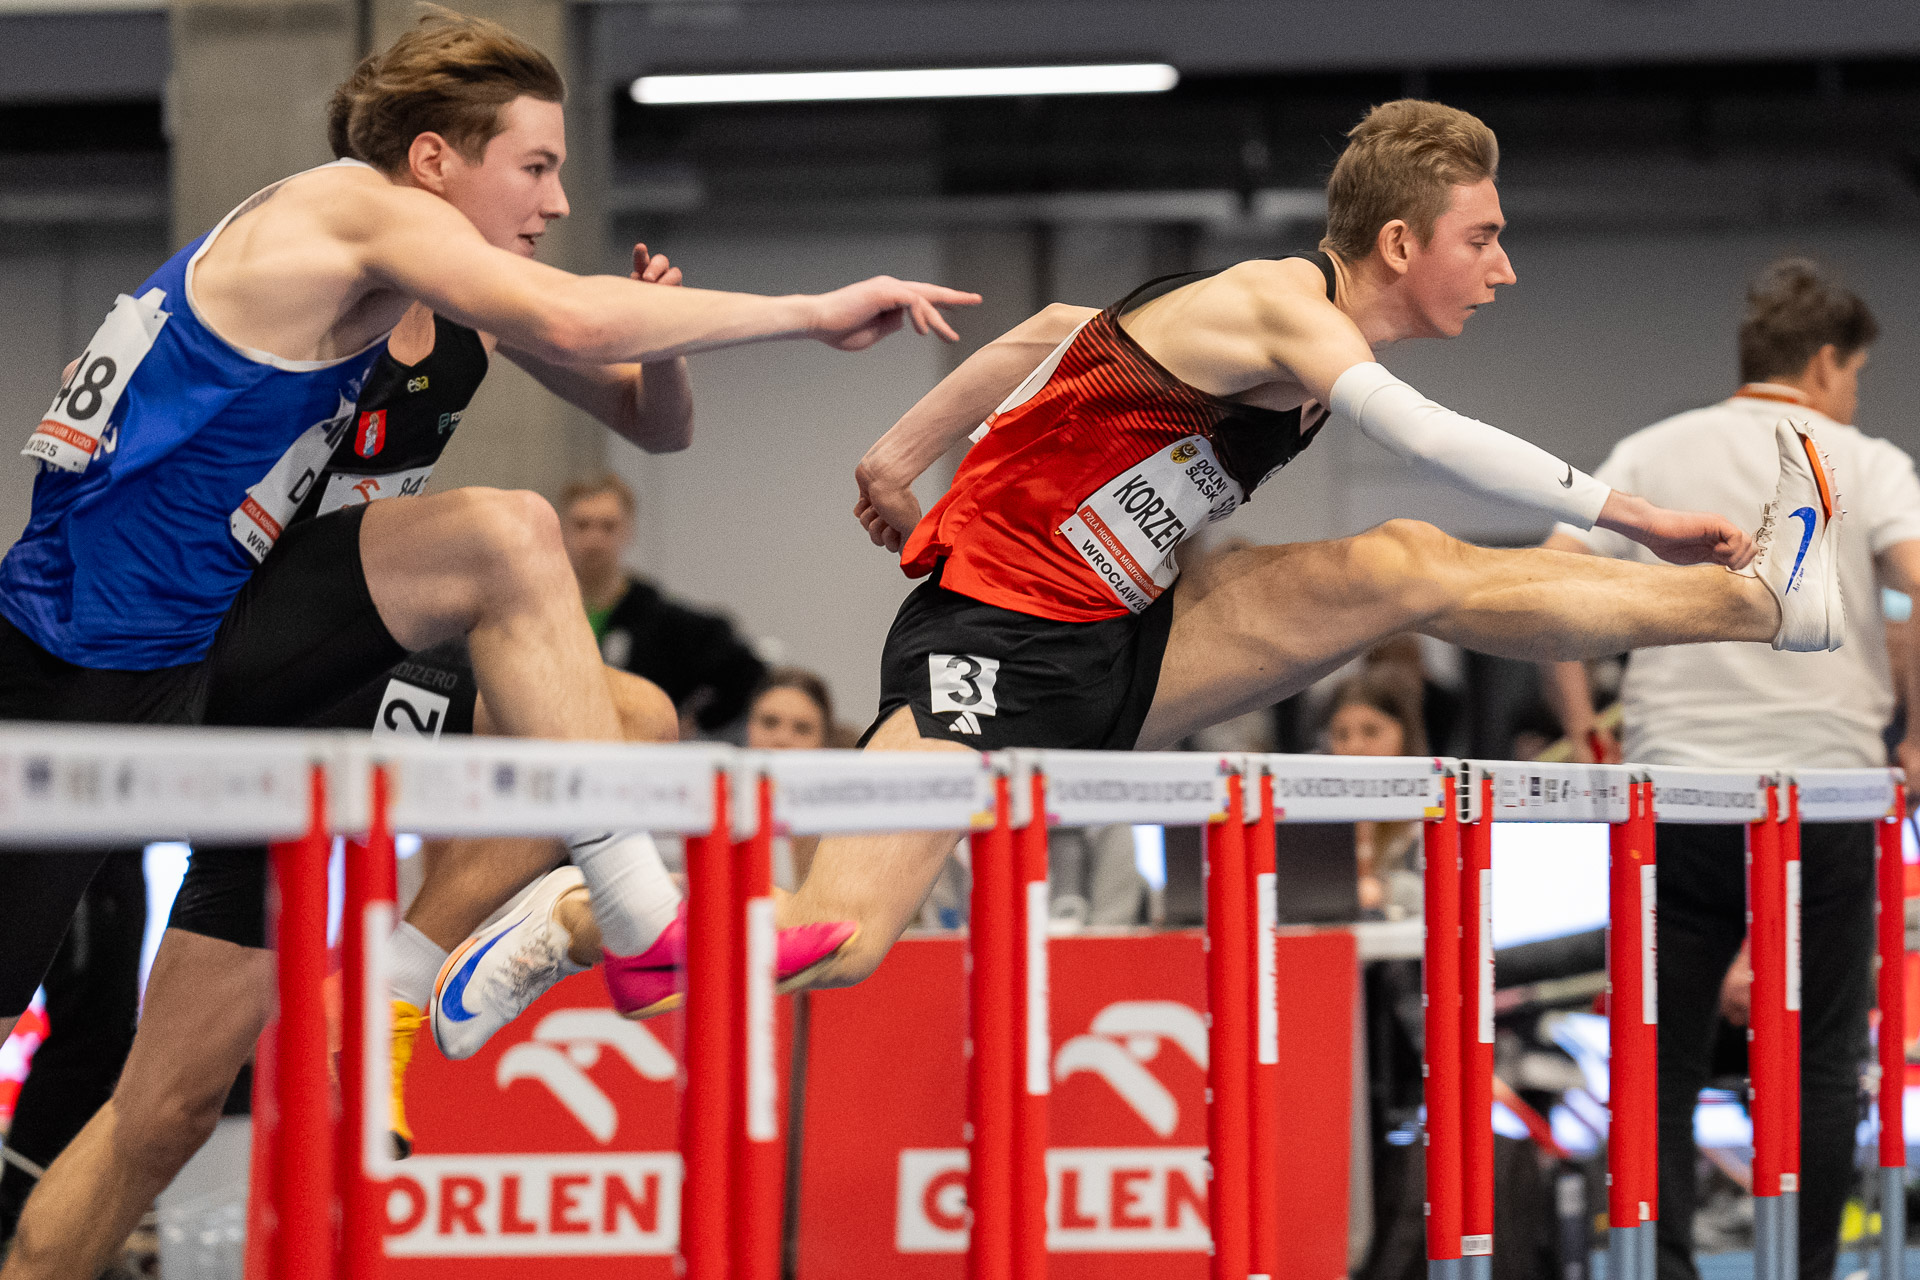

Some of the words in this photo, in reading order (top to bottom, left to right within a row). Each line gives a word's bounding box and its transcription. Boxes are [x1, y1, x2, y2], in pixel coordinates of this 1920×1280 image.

[407, 375, 429, 393] esa
[72, 433, 92, 449] U20
[1196, 459, 1229, 494] DOLNY
[1083, 511, 1101, 531] PZLA
[1096, 526, 1122, 557] Halowe
[1082, 538, 1140, 603] WROCŁAW
[946, 655, 983, 706] 3
[383, 698, 441, 738] 2
[382, 1172, 661, 1237] ORLEN
[922, 1168, 1210, 1231] OLEN
